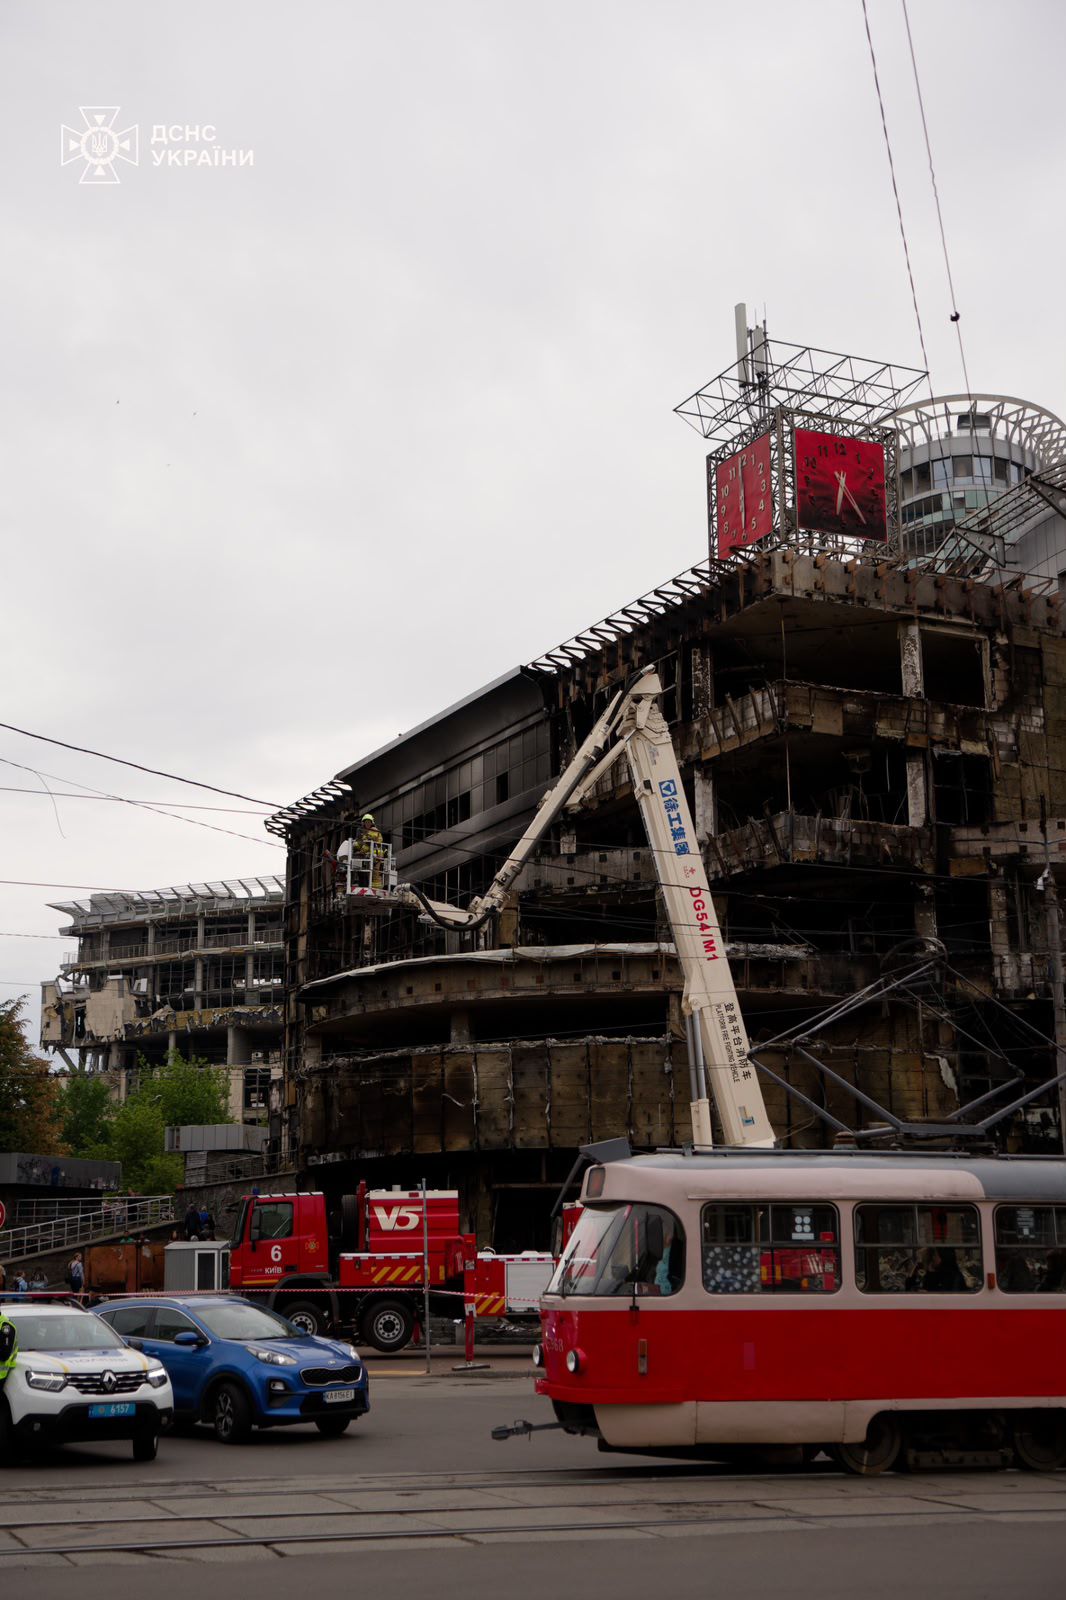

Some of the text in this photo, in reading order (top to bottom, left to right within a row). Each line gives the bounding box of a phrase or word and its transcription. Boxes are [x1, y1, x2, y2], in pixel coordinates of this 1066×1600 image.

[729, 467, 736, 481] 11
[758, 462, 764, 475] 2
[720, 484, 729, 499] 10
[761, 479, 767, 493] 3
[721, 504, 726, 518] 9
[758, 499, 765, 512] 4
[723, 521, 729, 534] 8
[751, 516, 757, 530] 5
[690, 887, 719, 961] DG54/M1
[373, 1205, 424, 1232] V5
[270, 1244, 283, 1262] 6
[264, 1265, 283, 1275] КИЇВ
[110, 1403, 130, 1414] 6157
